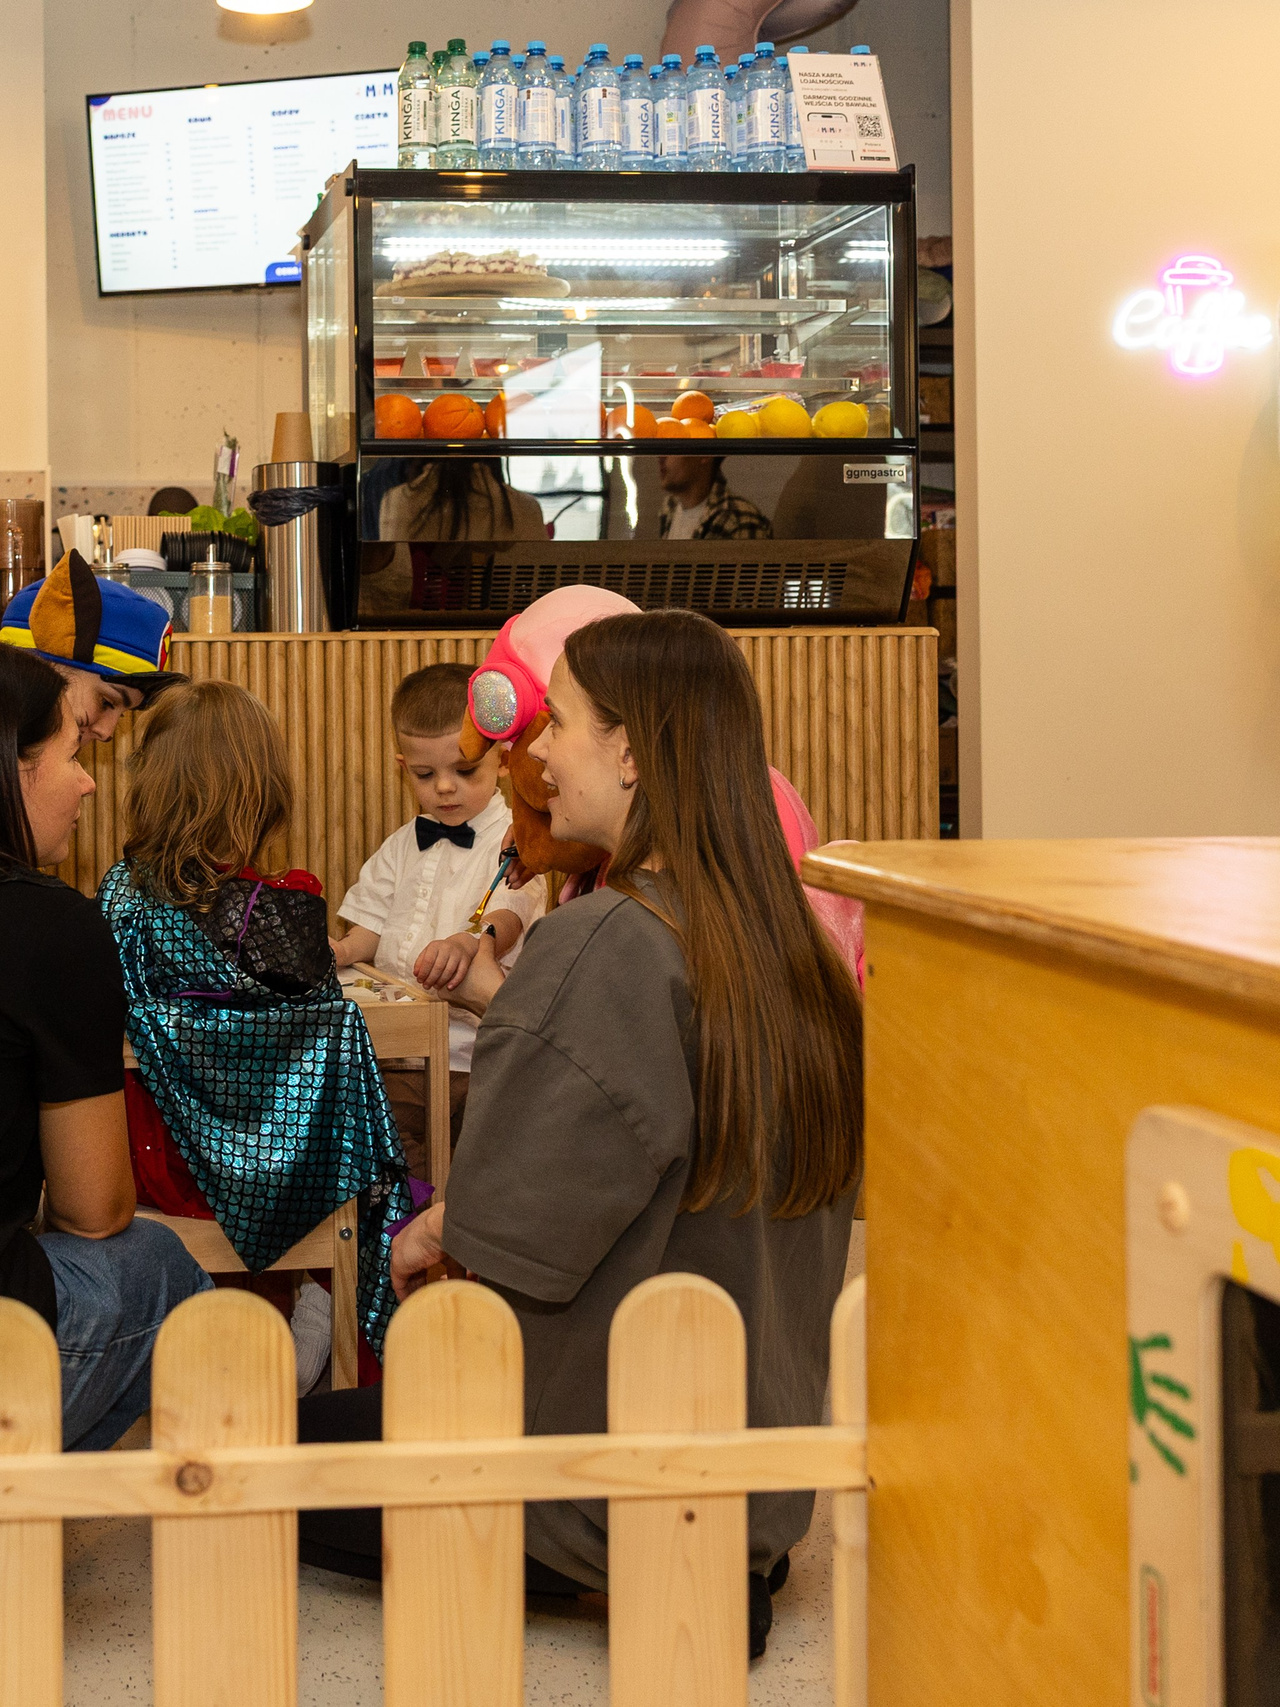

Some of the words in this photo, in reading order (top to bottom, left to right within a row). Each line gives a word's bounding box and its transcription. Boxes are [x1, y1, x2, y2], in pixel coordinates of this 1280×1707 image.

[103, 105, 153, 121] MENU
[403, 92, 412, 140] KINGA
[451, 90, 460, 137] KINGA
[495, 87, 505, 135] KINGA
[640, 102, 649, 148] KINGA
[711, 92, 720, 139] KINGA
[770, 91, 780, 139] KINGA
[846, 468, 904, 479] ggmgastro
